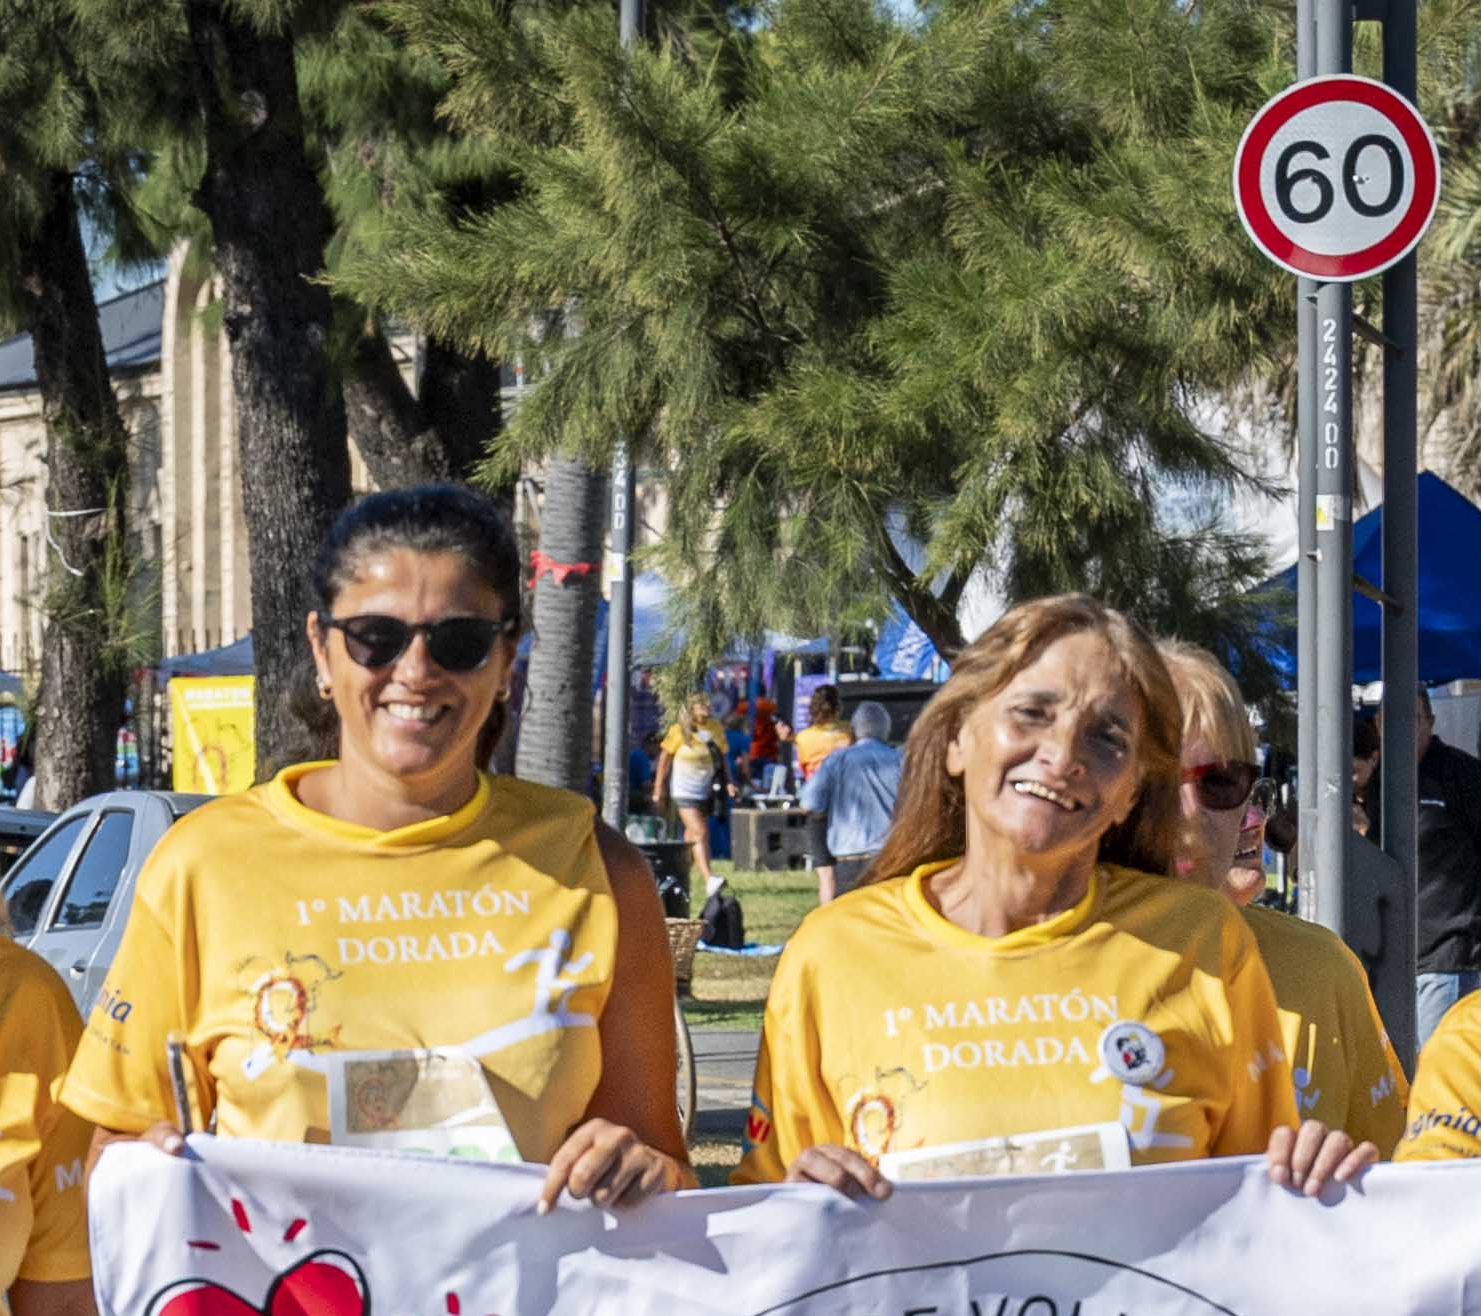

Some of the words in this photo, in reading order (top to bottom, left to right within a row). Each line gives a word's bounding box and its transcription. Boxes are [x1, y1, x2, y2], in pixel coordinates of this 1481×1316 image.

[1275, 133, 1405, 224] 60
[336, 883, 532, 924] MARATÓN
[336, 930, 505, 965] DORADA
[924, 988, 1119, 1031] MARATÓN
[922, 1036, 1091, 1073] DORADA
